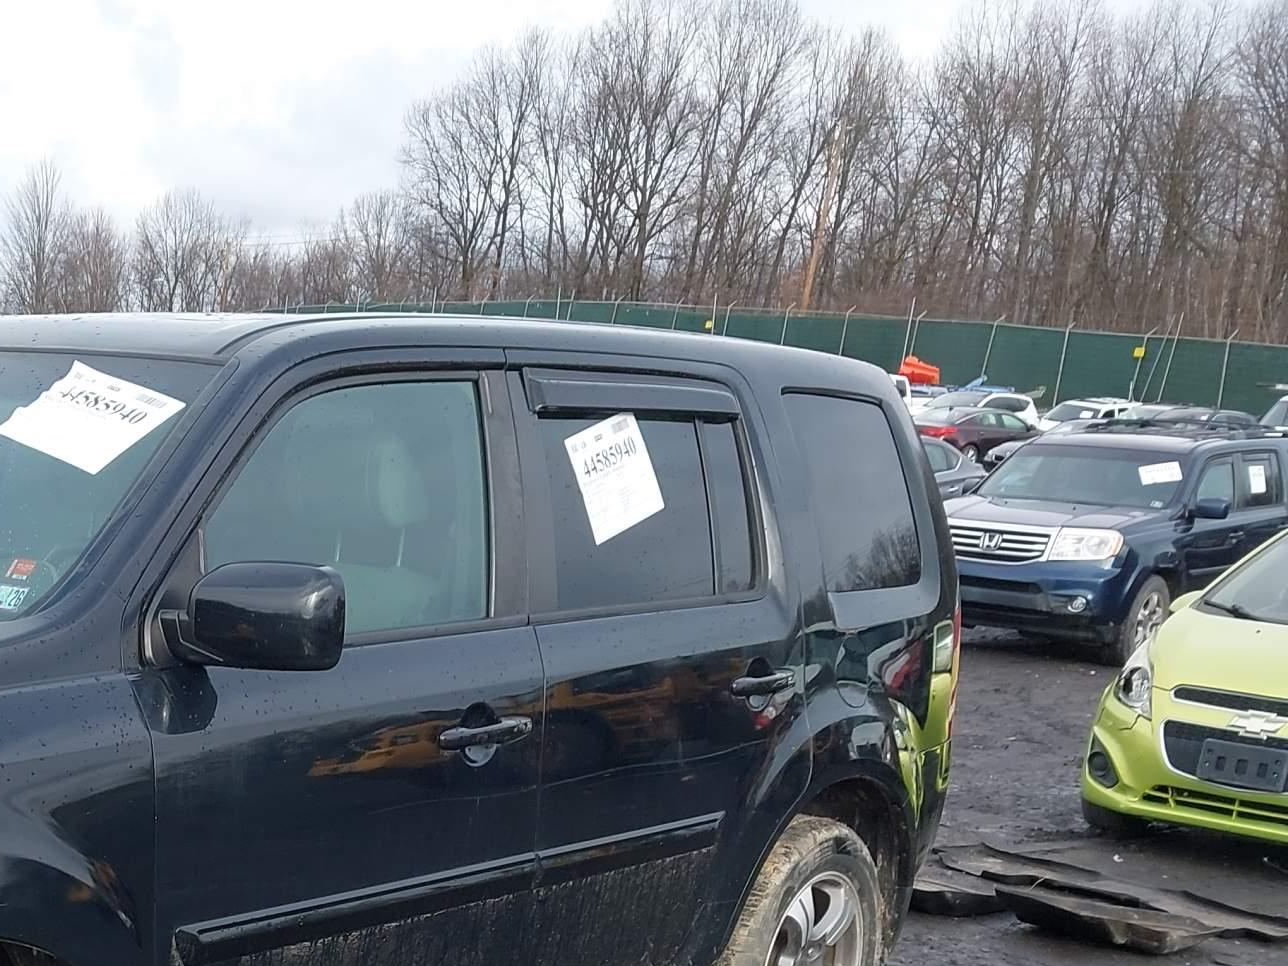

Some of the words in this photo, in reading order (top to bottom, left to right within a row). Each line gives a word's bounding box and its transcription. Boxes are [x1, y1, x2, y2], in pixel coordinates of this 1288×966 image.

[59, 385, 148, 425] 44585940
[583, 435, 637, 478] 44585940
[8, 589, 26, 607] 26
